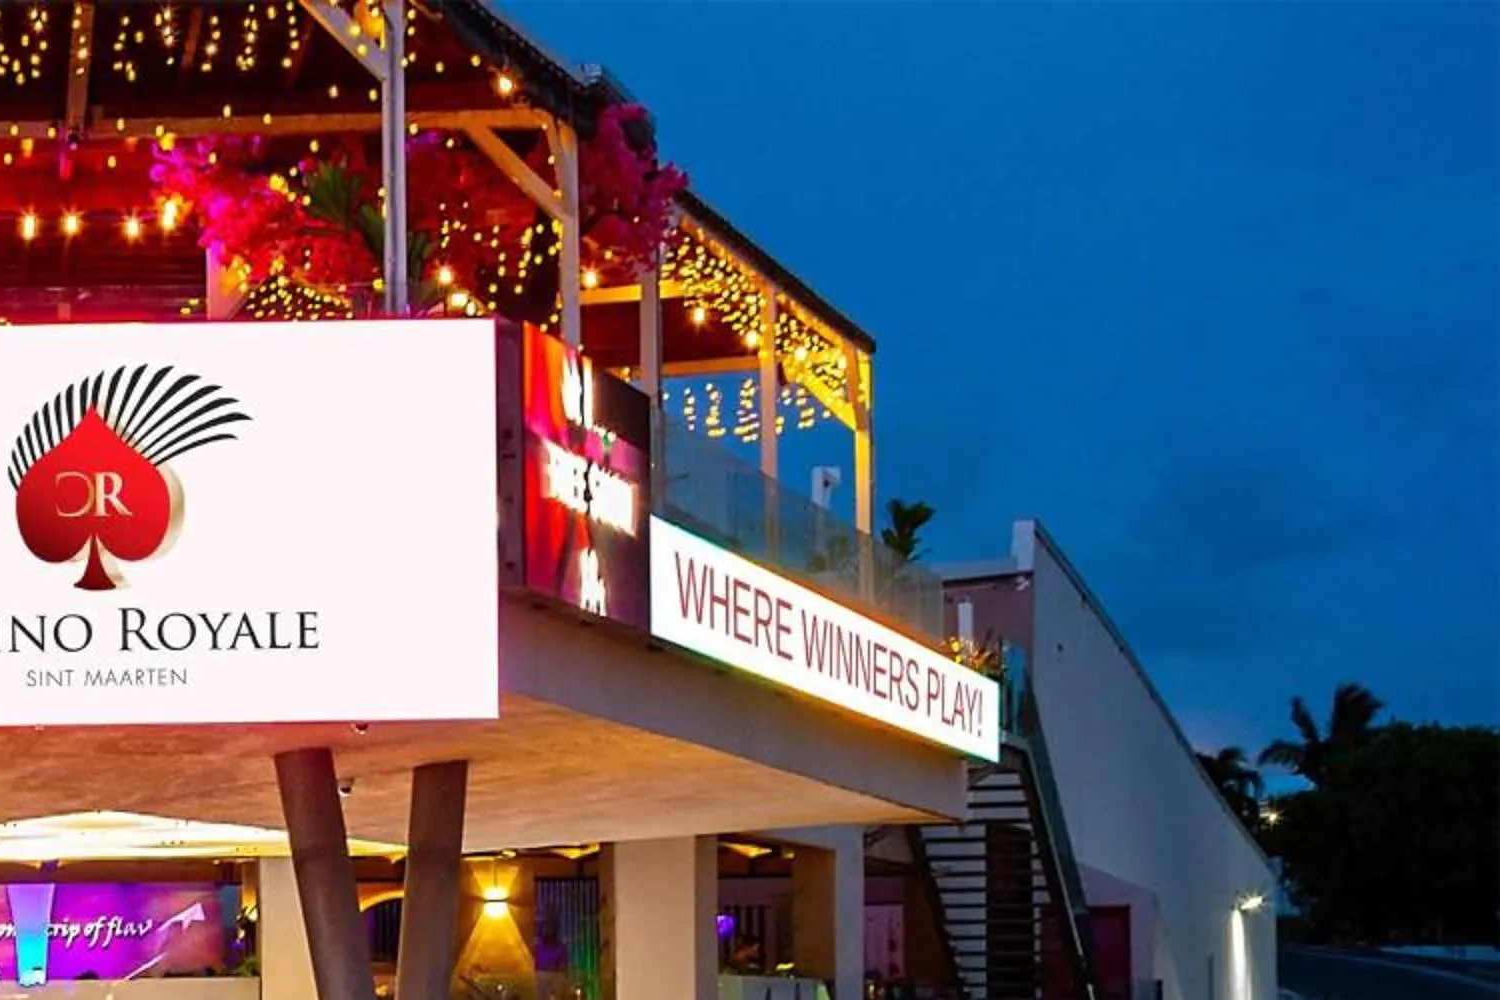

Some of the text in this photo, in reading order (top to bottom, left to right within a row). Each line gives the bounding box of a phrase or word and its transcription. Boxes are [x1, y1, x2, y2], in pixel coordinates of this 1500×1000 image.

[119, 607, 320, 652] ROYALE
[675, 551, 793, 661] WHERE
[801, 609, 920, 711] WINNERS
[927, 667, 984, 738] PLAY!
[27, 667, 187, 687] SINT MAARTEN
